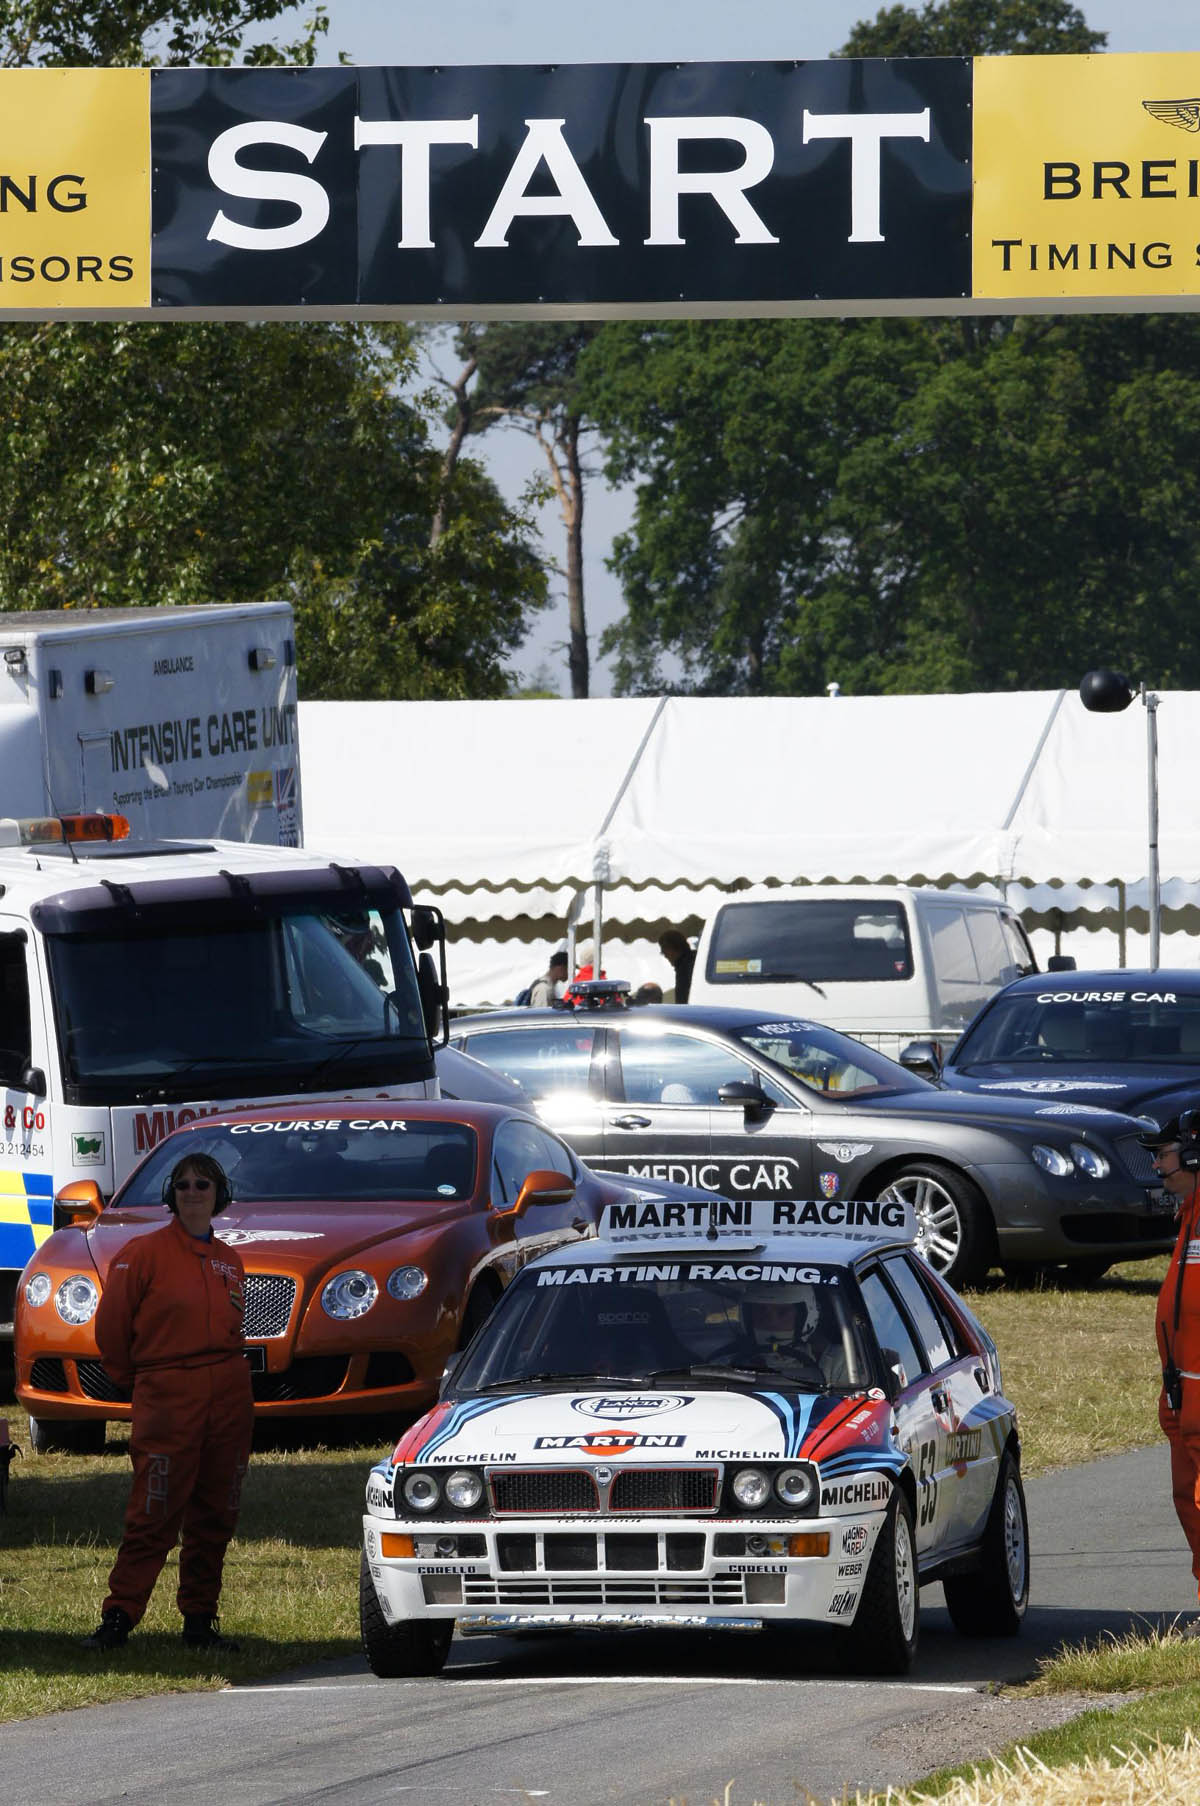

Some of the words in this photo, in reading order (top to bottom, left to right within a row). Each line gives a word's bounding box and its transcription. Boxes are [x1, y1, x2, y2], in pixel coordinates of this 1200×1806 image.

[207, 107, 931, 250] START
[0, 174, 87, 213] NG
[992, 239, 1173, 271] TIMING
[153, 656, 194, 676] AMBULANCE
[110, 718, 201, 772] INTENSIVE
[207, 709, 257, 757] CARE
[262, 704, 295, 748] UNIT
[1037, 992, 1125, 1004] COURSE
[1131, 992, 1177, 1003] CAR
[5, 1105, 16, 1128] &
[24, 1106, 45, 1130] Co
[230, 1120, 342, 1134] COURSE
[349, 1120, 407, 1131] CAR
[8, 1142, 44, 1157] 212454
[730, 1165, 792, 1190] CAR
[609, 1202, 752, 1229] MARTINI
[772, 1201, 906, 1227] RACING
[537, 1265, 680, 1287] MARTINI
[688, 1264, 821, 1285] RACING
[540, 1436, 678, 1447] MARTINI
[433, 1453, 517, 1464] MICHELIN
[695, 1450, 780, 1459] MICHELIN
[821, 1480, 890, 1506] MICHELIN
[418, 1566, 476, 1574] CARELLO
[729, 1565, 788, 1573] CARELLO
[837, 1563, 862, 1577] WEBER
